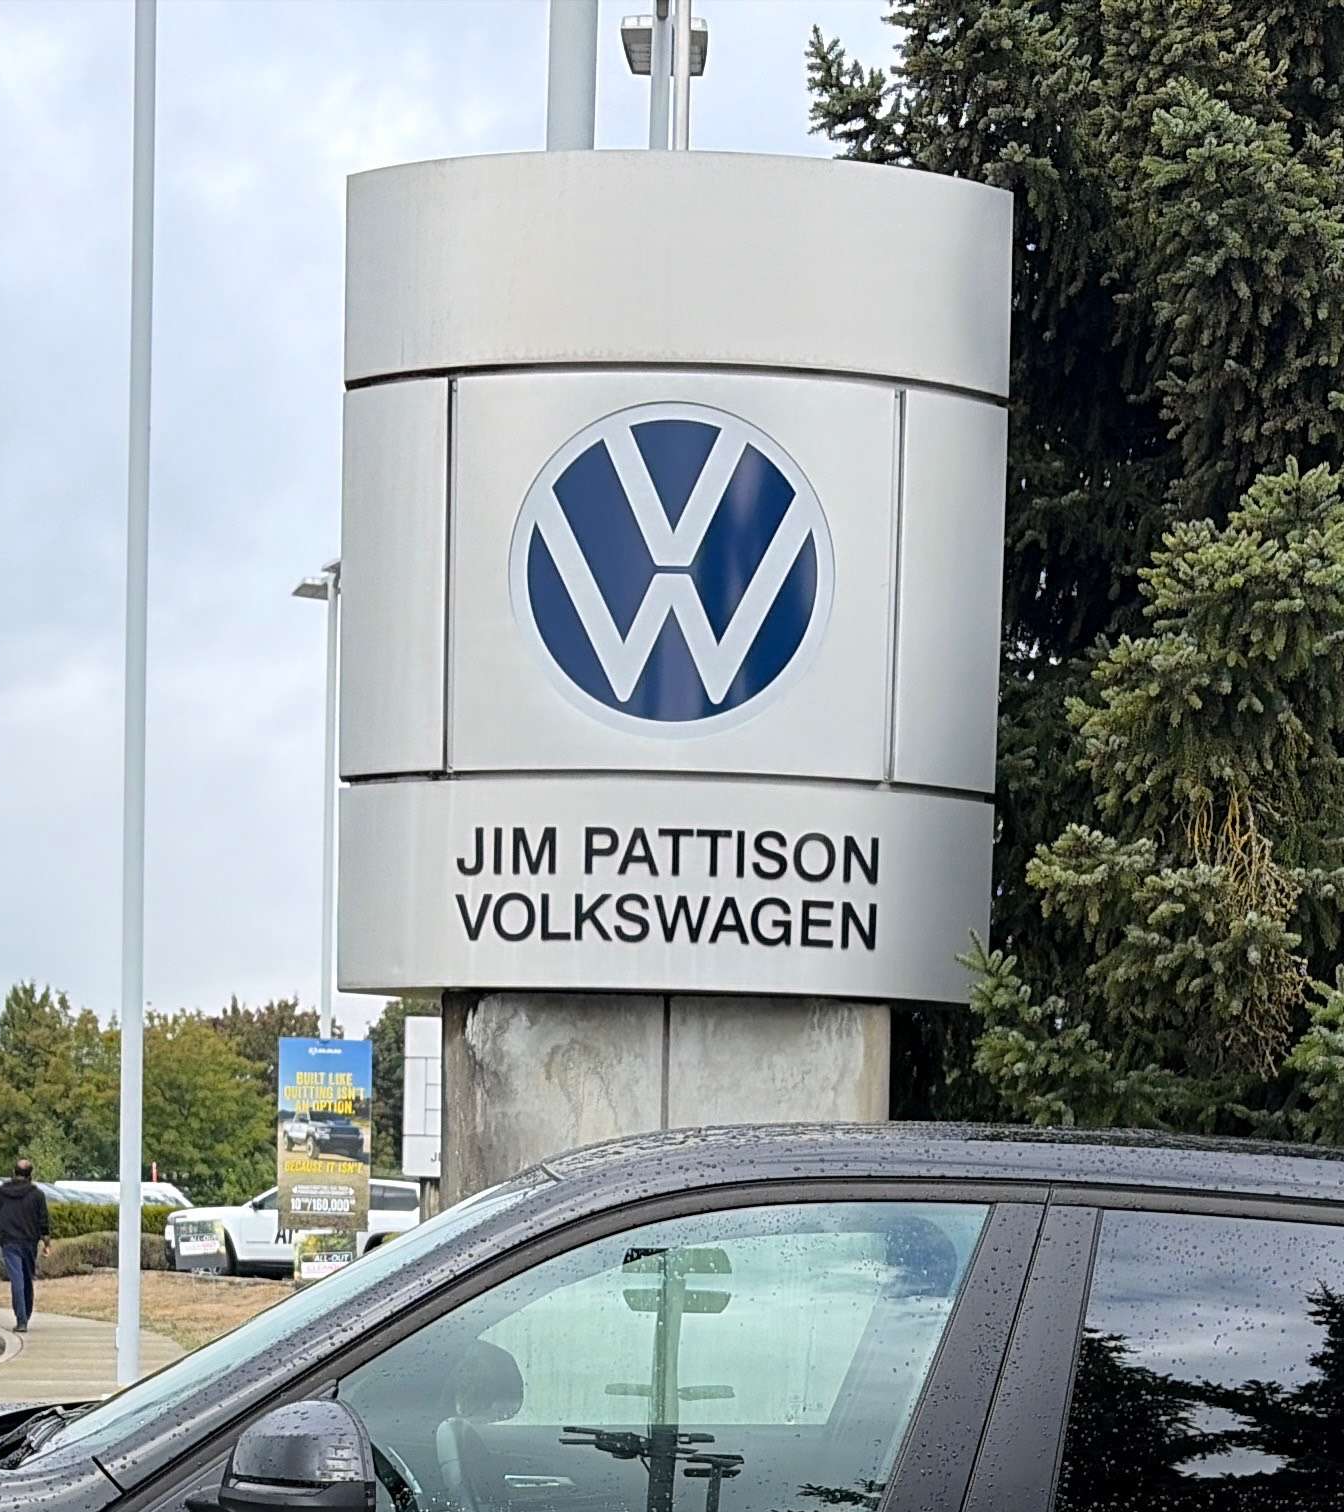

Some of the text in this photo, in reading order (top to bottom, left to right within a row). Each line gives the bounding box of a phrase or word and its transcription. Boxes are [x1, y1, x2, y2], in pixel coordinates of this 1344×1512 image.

[529, 418, 814, 706] VW
[456, 827, 880, 885] JIM PATTISON
[456, 893, 878, 951] VOLKSWAGEN
[283, 1086, 334, 1100] QUITTING
[296, 1071, 353, 1086] BUILT LIKE
[313, 1253, 350, 1263] ALL-OUT
